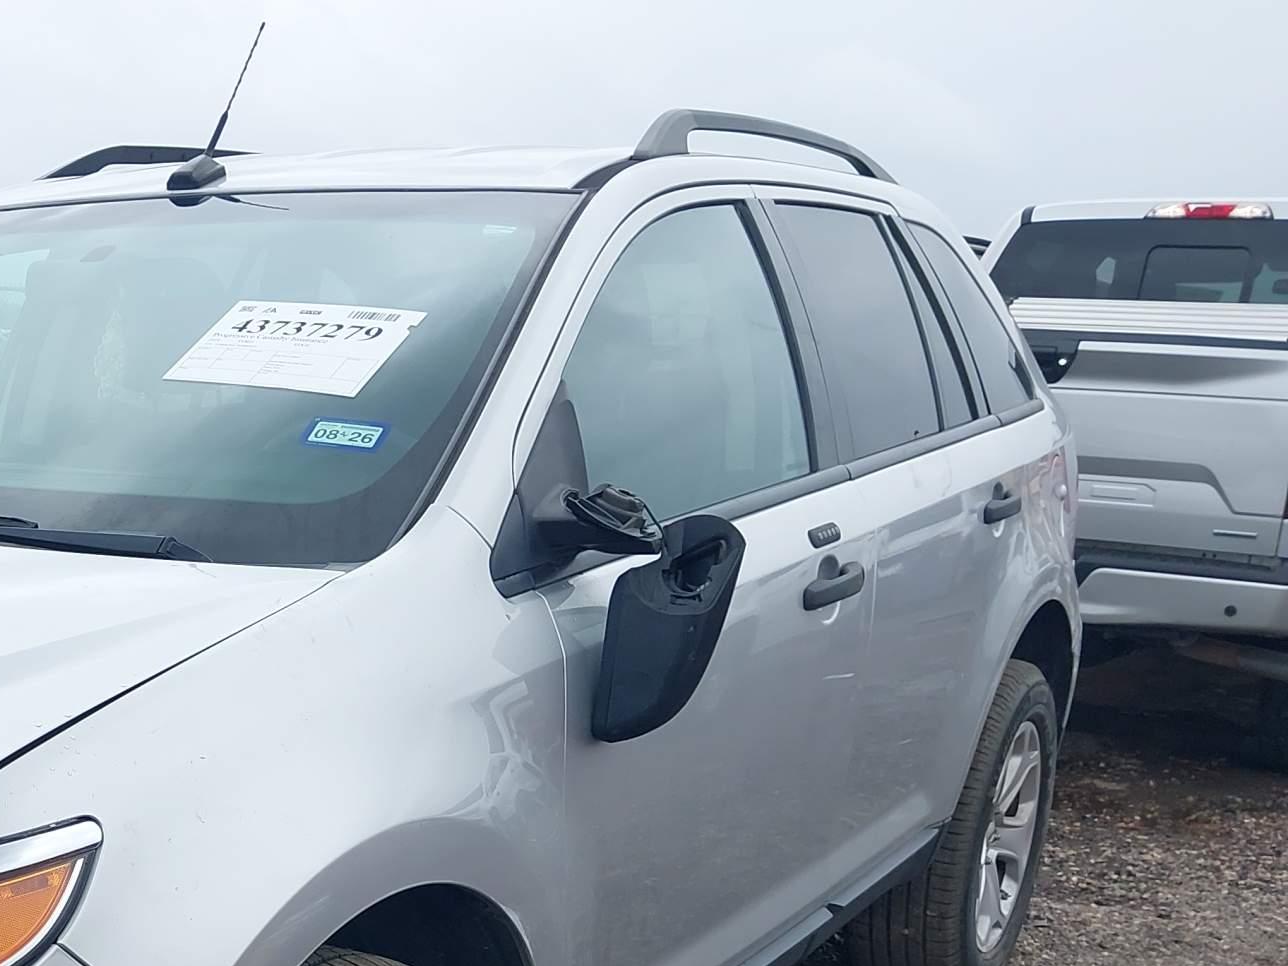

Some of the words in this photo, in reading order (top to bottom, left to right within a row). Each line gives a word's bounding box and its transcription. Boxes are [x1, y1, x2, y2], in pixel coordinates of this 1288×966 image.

[231, 318, 384, 341] 43737279
[314, 428, 340, 440] 08
[348, 431, 375, 444] 26
